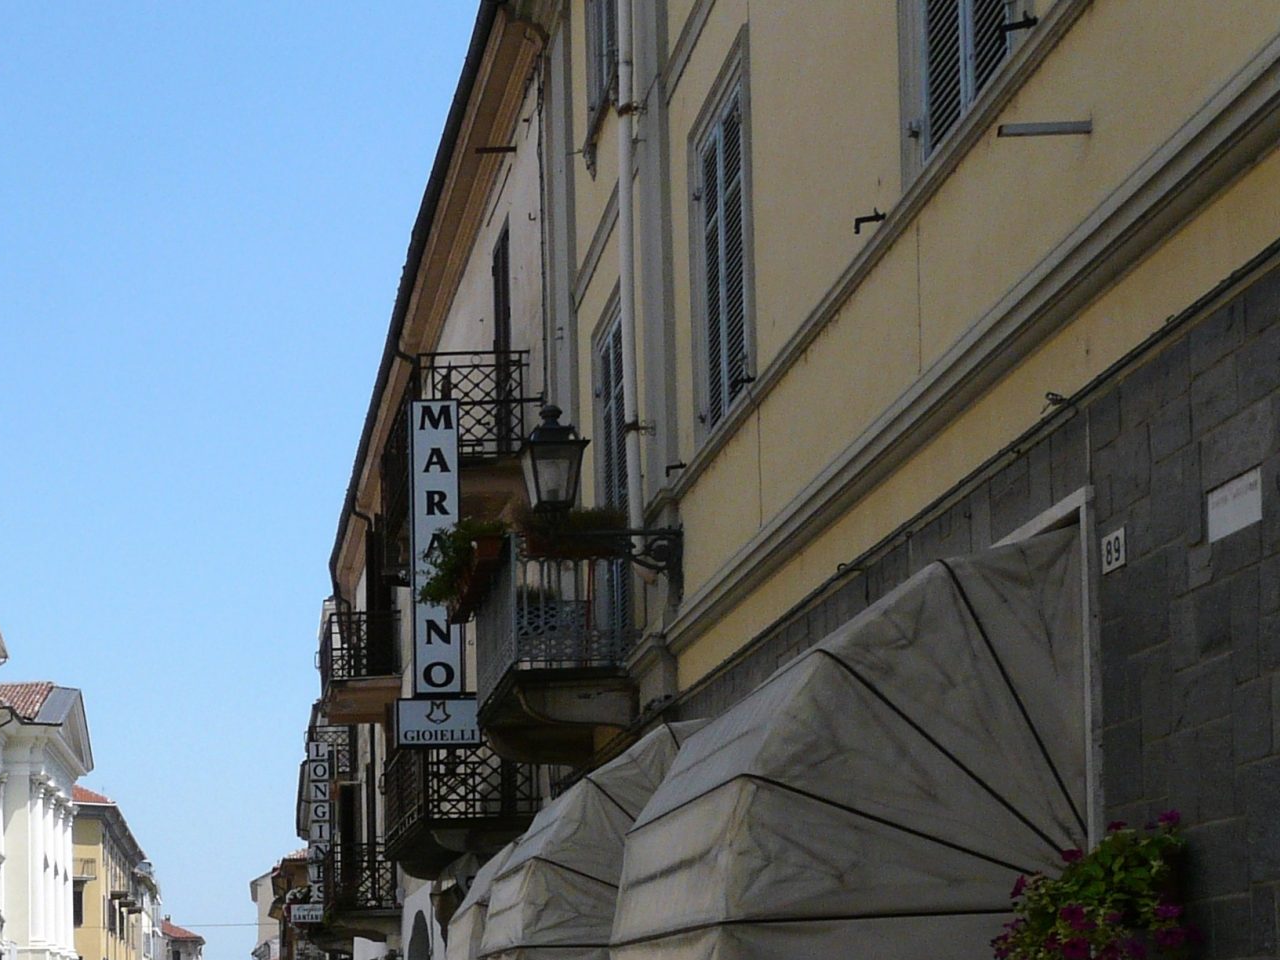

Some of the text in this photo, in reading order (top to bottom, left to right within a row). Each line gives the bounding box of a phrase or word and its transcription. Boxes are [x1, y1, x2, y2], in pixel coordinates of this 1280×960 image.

[418, 404, 455, 689] MARANO
[1105, 535, 1121, 566] 89
[403, 729, 476, 742] GIOIELLI
